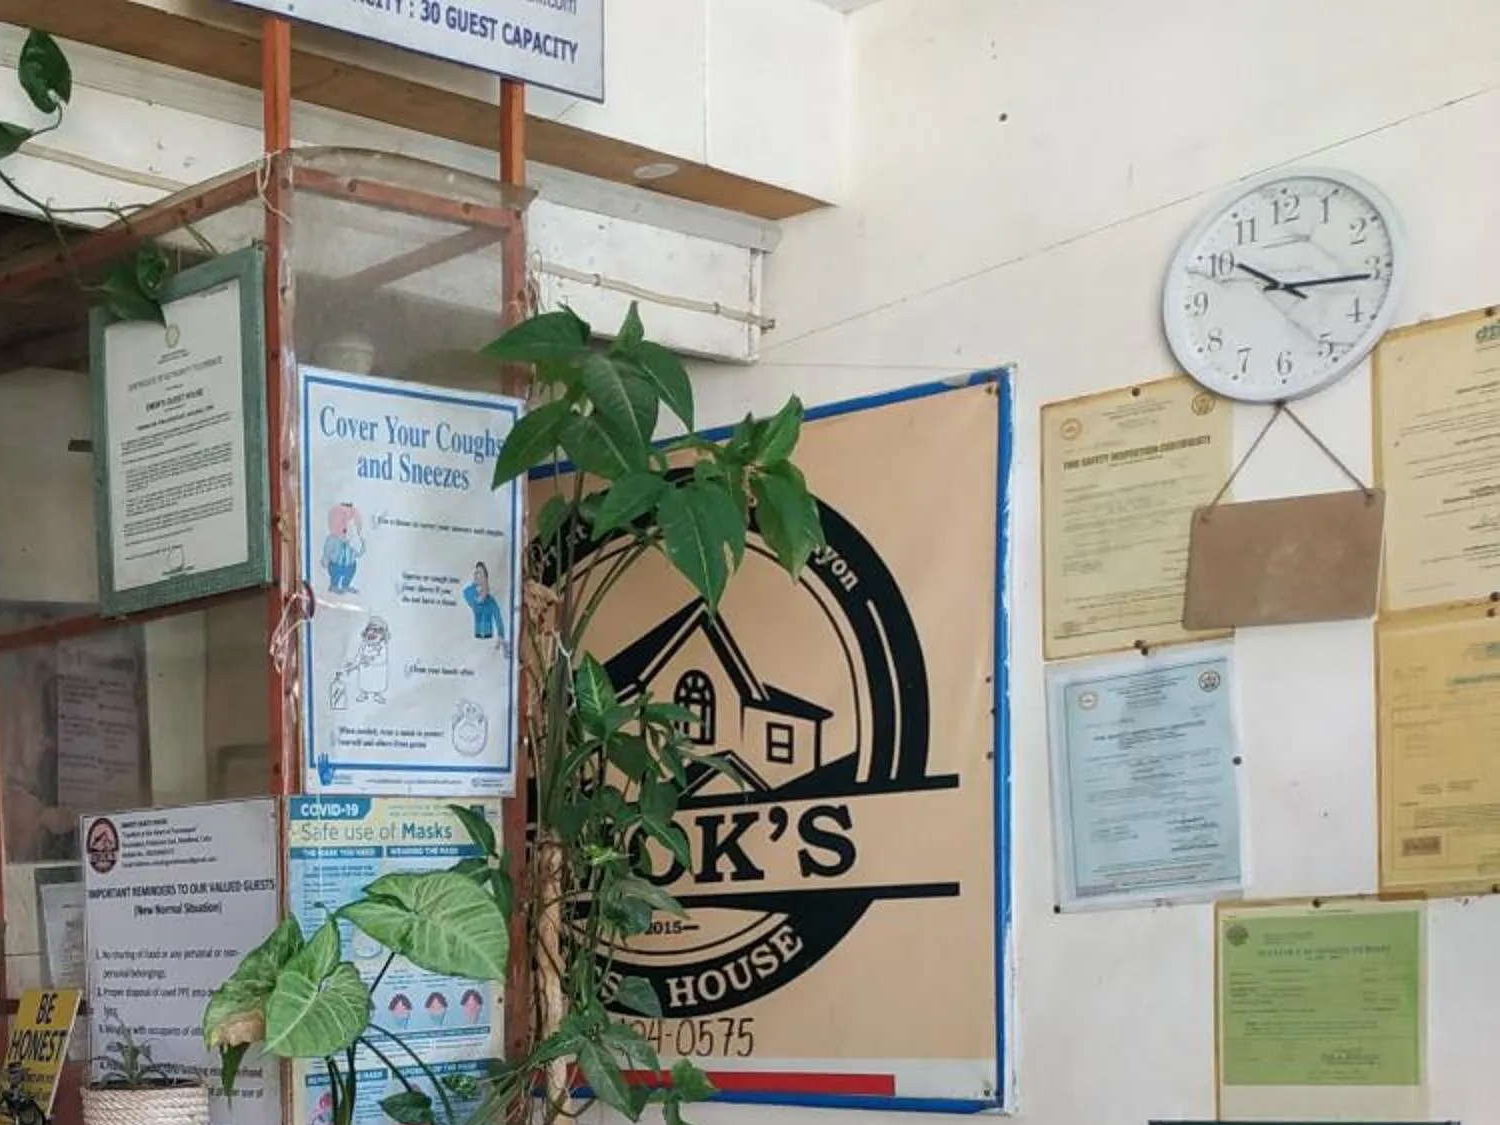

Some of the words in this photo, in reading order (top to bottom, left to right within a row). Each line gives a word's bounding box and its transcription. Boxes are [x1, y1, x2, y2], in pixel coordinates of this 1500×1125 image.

[420, 0, 440, 25] 30
[445, 6, 498, 41] GUEST
[501, 22, 578, 64] CAPACITY
[1271, 194, 1300, 225] 12
[1320, 197, 1330, 225] 1
[1236, 218, 1258, 245] 11
[1350, 217, 1367, 245] 2
[1210, 250, 1235, 278] 10
[1365, 255, 1381, 281] 3
[1193, 291, 1208, 317] 9
[1346, 296, 1364, 322] 4
[1207, 327, 1223, 351] 8
[1318, 332, 1334, 358] 5
[1237, 347, 1252, 373] 7
[1277, 351, 1292, 376] 6
[320, 405, 378, 442] Cover
[384, 415, 431, 449] Your
[436, 422, 504, 464] Coughs
[357, 453, 393, 481] and
[399, 455, 470, 490] Sneezes
[301, 803, 359, 817] COVID-19
[301, 822, 339, 841] Safe
[344, 825, 374, 839] use
[379, 820, 396, 838] of
[401, 822, 453, 840] Masks
[590, 804, 857, 887] OK'S
[132, 884, 177, 898] REMINDERS
[178, 883, 188, 895] TO
[189, 882, 208, 894] OUR
[209, 880, 242, 893] VALUED
[244, 878, 276, 893] GUESTS
[666, 923, 804, 1008] HOUSE
[36, 992, 58, 1025] BE
[8, 1028, 68, 1062] HONEST
[621, 1017, 755, 1057] 4-0575
